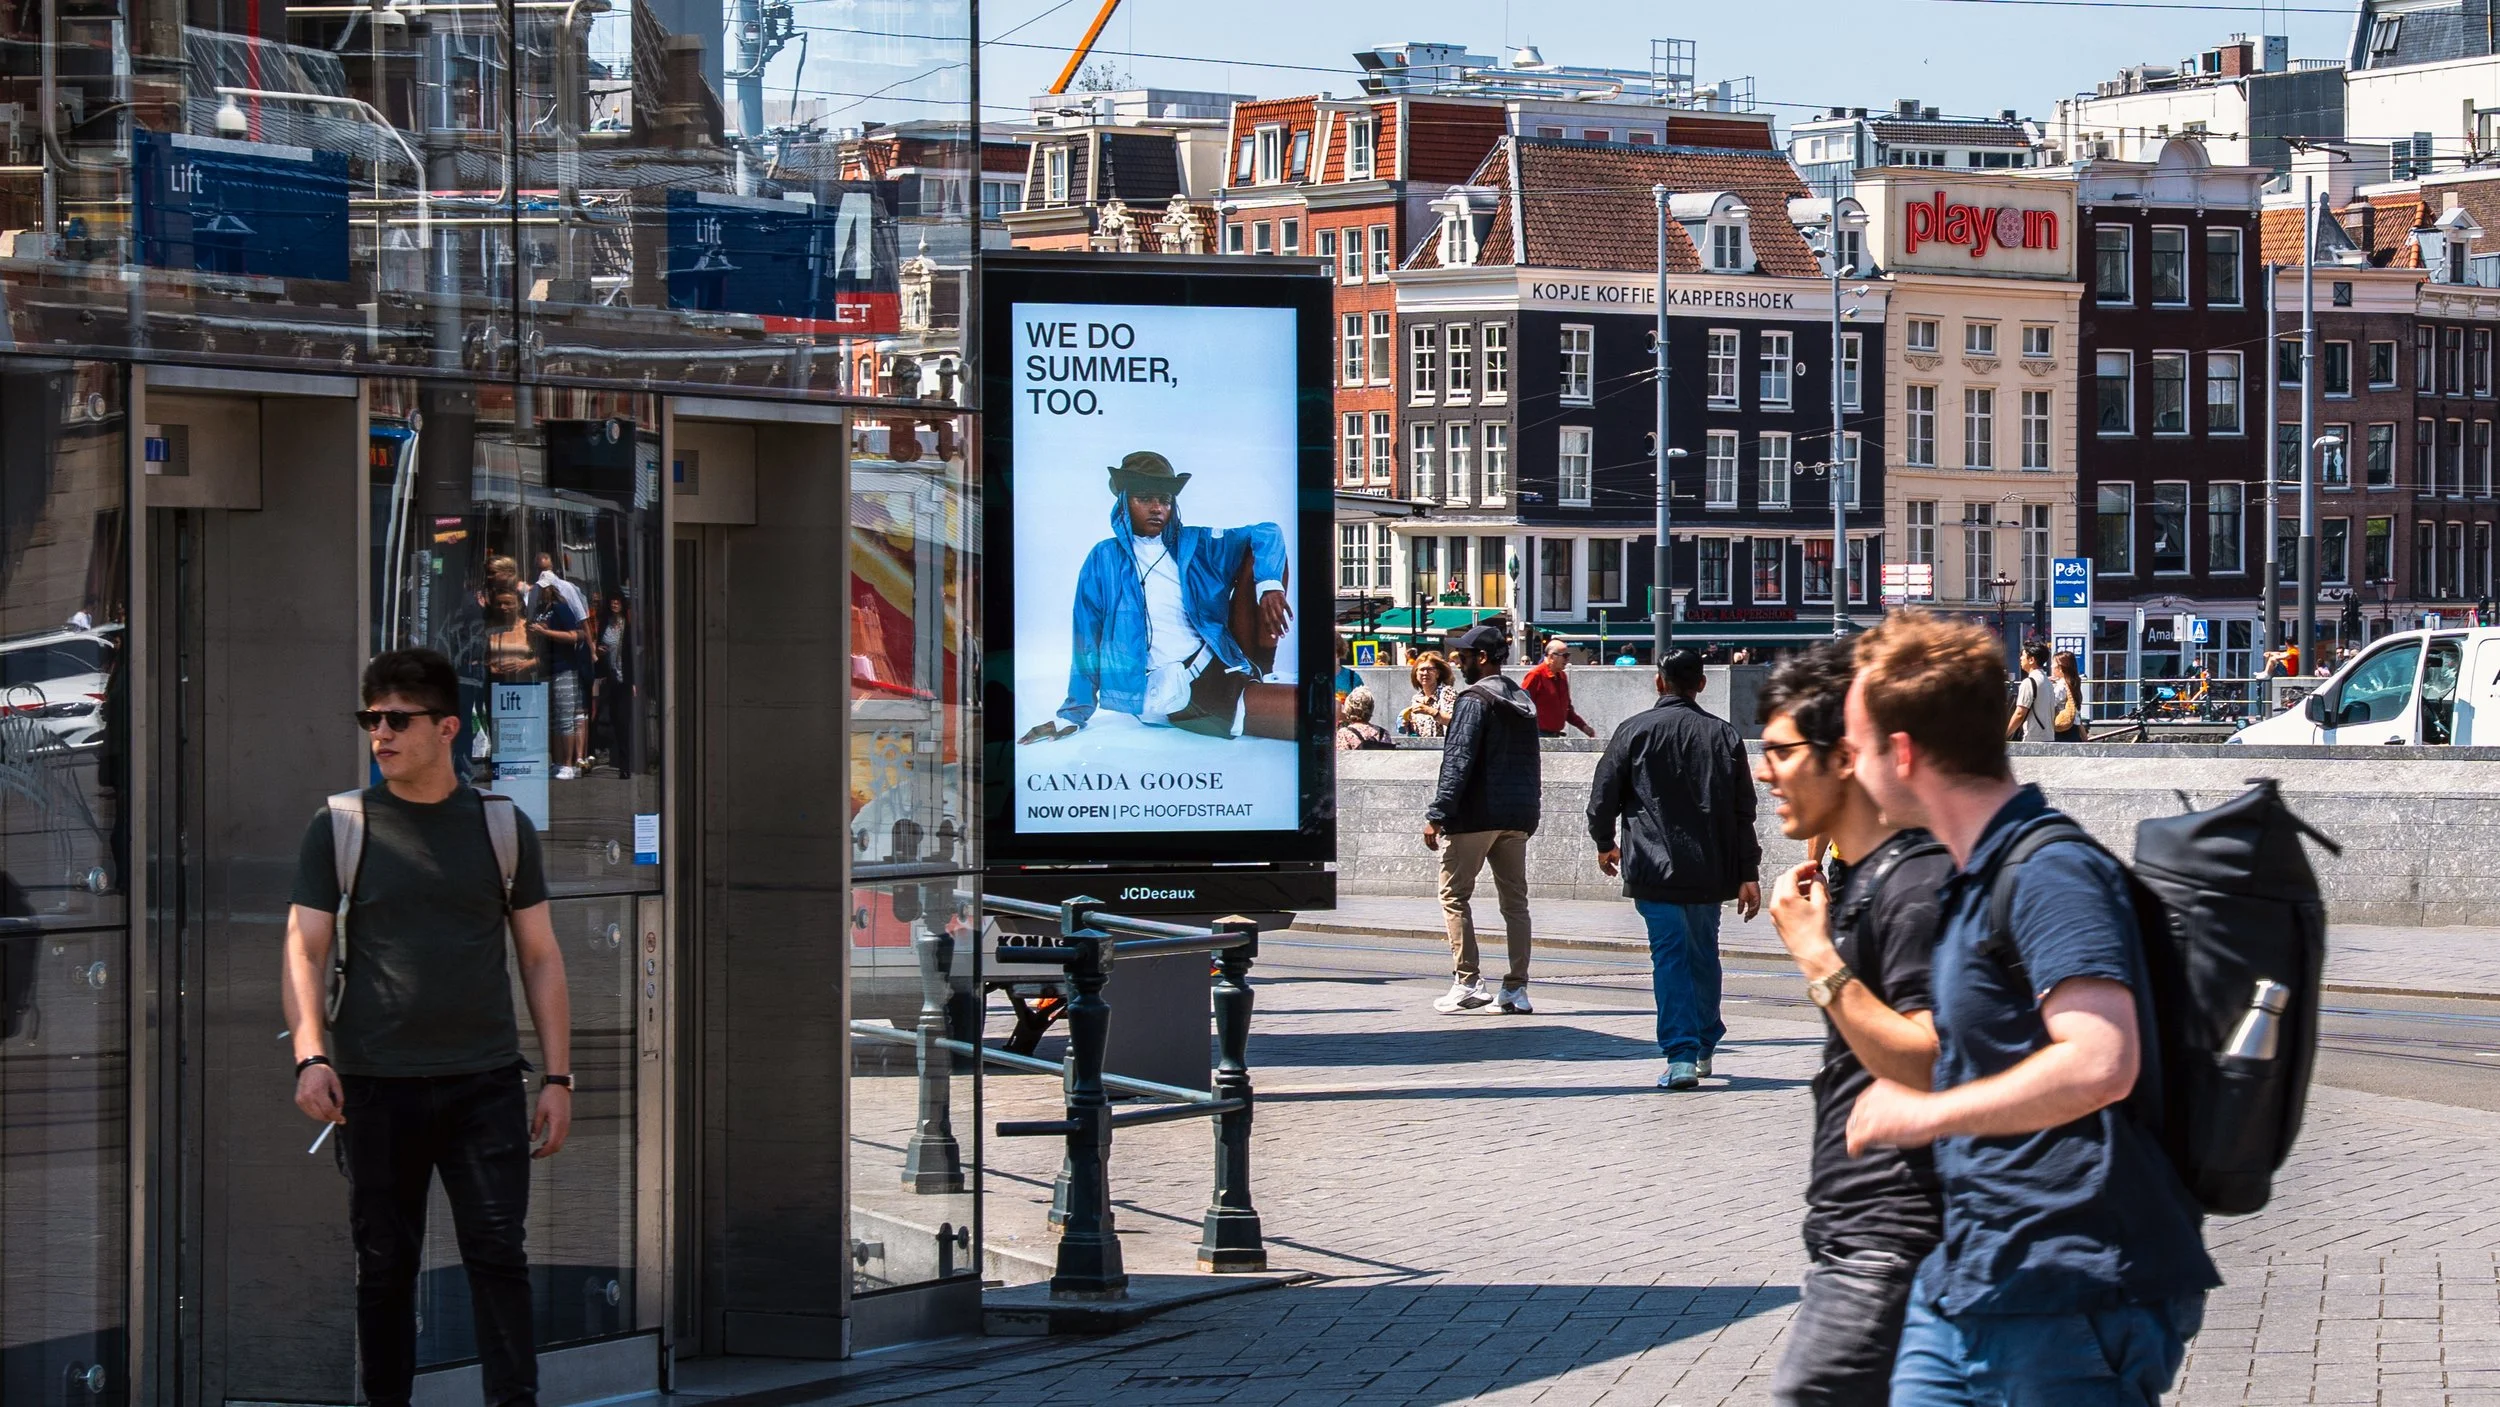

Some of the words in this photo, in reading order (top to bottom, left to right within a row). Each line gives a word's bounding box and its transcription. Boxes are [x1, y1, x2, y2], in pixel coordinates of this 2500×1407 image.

[171, 163, 203, 194] Lift
[696, 217, 722, 245] Lift
[1532, 282, 1590, 301] KOPJE
[1597, 285, 1655, 304] KOFFIE
[1667, 288, 1794, 310] KARPERSHOEK
[1026, 322, 1077, 348] WE
[1088, 322, 1135, 350] DO
[1026, 354, 1178, 388] SUMMER,
[1026, 388, 1103, 416] TOO.
[2055, 562, 2066, 577] P
[500, 690, 521, 711] Lift
[1027, 773, 1130, 792] CANADA
[1140, 772, 1224, 791] GOOSE
[1027, 805, 1064, 819] NOW
[1068, 805, 1110, 819] OPEN
[1120, 805, 1140, 818] PC
[1144, 803, 1253, 818] HOOFDSTRAAT
[1120, 887, 1195, 900] JCDecaux
